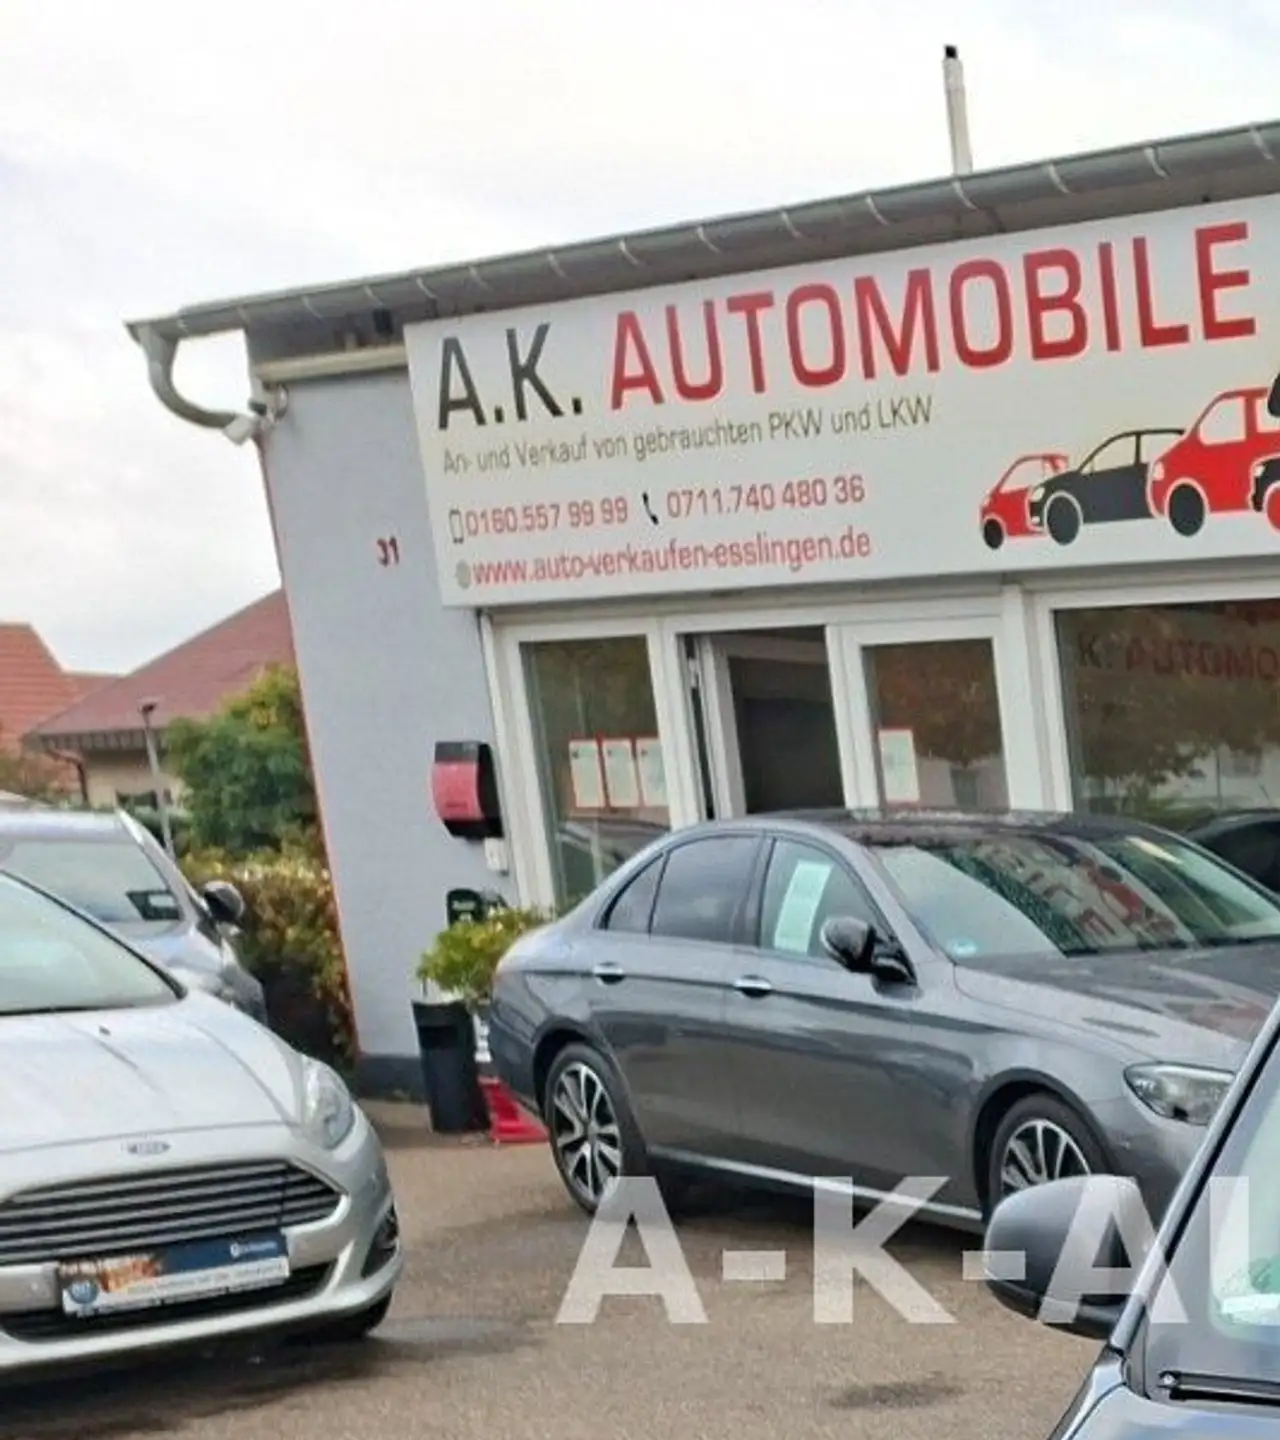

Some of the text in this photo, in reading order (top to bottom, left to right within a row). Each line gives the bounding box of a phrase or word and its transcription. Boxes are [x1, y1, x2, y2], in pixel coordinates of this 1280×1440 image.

[437, 221, 1258, 431] A.K. AUTOMOBILE
[443, 394, 933, 475] An- und Verkauf von gebrauchten PKW und LKW
[567, 499, 595, 528] 99
[601, 496, 629, 525] 99
[666, 482, 776, 519] 0711.740
[781, 477, 828, 508] 480
[833, 473, 866, 504] 36
[473, 524, 871, 586] www.auto-verkaufen-esslingen.de
